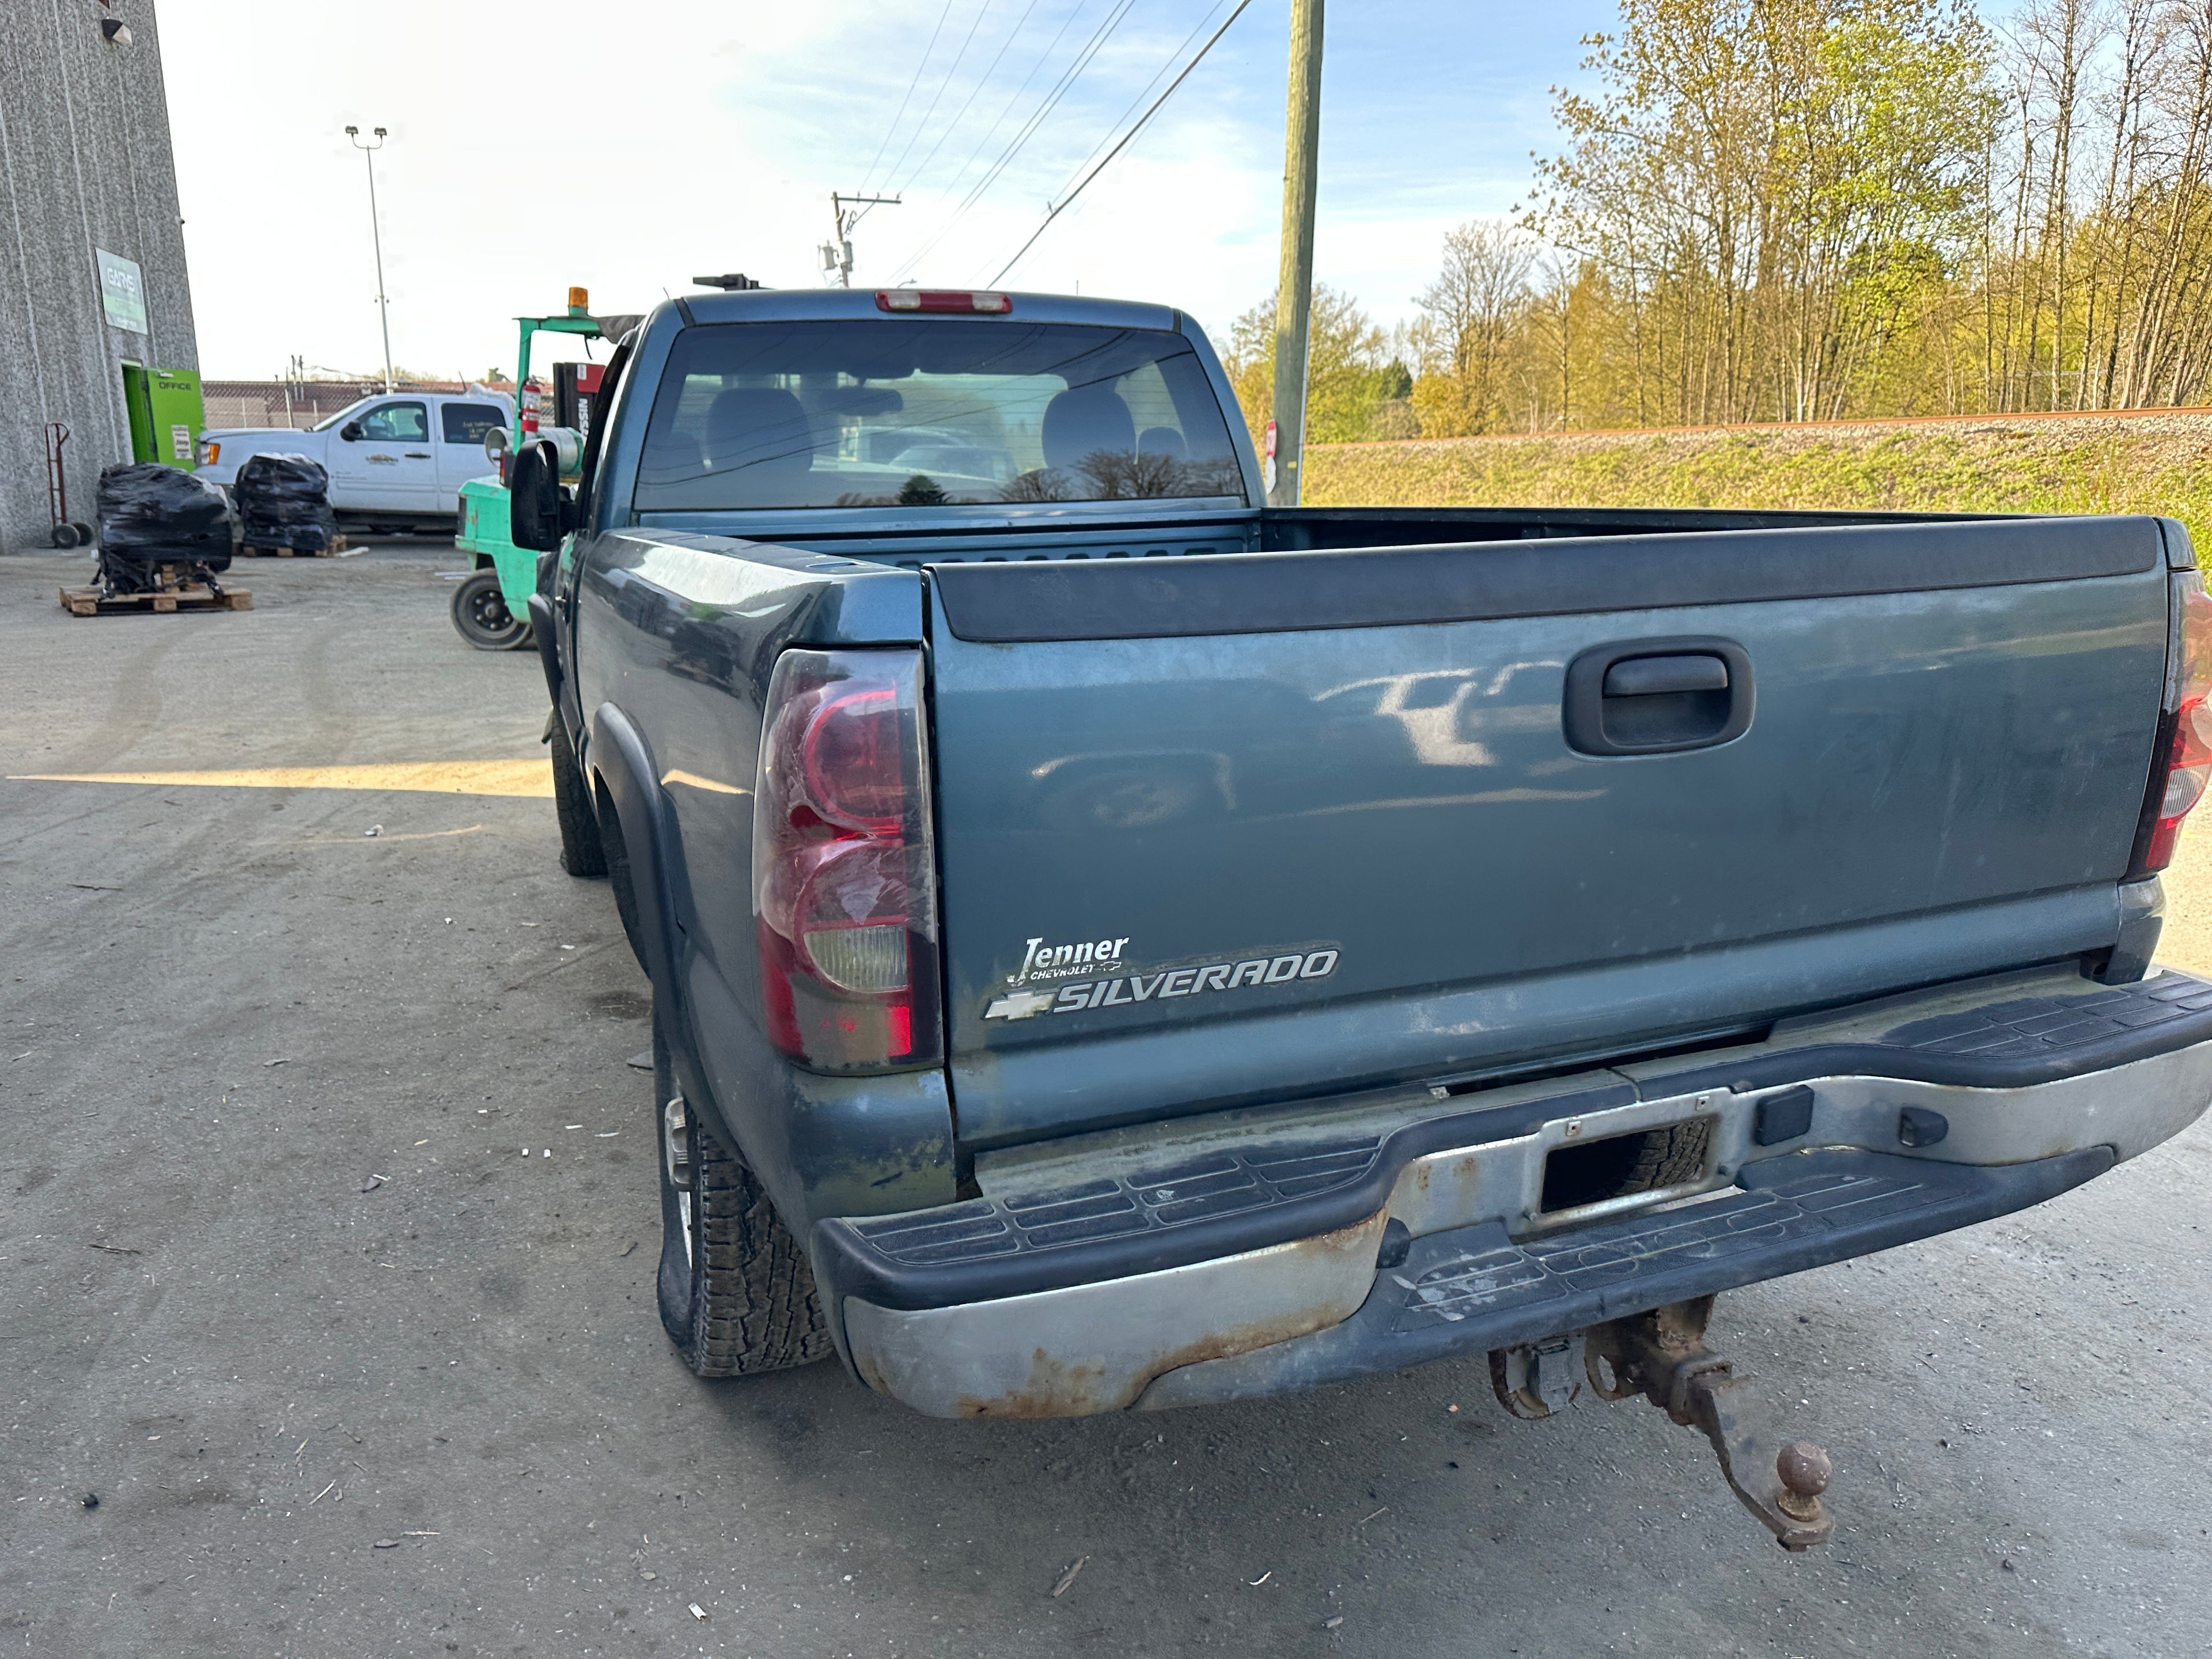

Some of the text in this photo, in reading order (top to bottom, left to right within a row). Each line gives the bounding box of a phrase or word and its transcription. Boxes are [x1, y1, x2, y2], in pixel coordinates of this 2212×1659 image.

[159, 382, 191, 391] OFFICE
[578, 398, 589, 437] NISSA
[1007, 937, 1130, 987] Jenner
[1030, 964, 1095, 980] CHEVROLET
[1053, 950, 1338, 1013] SILVERADO
